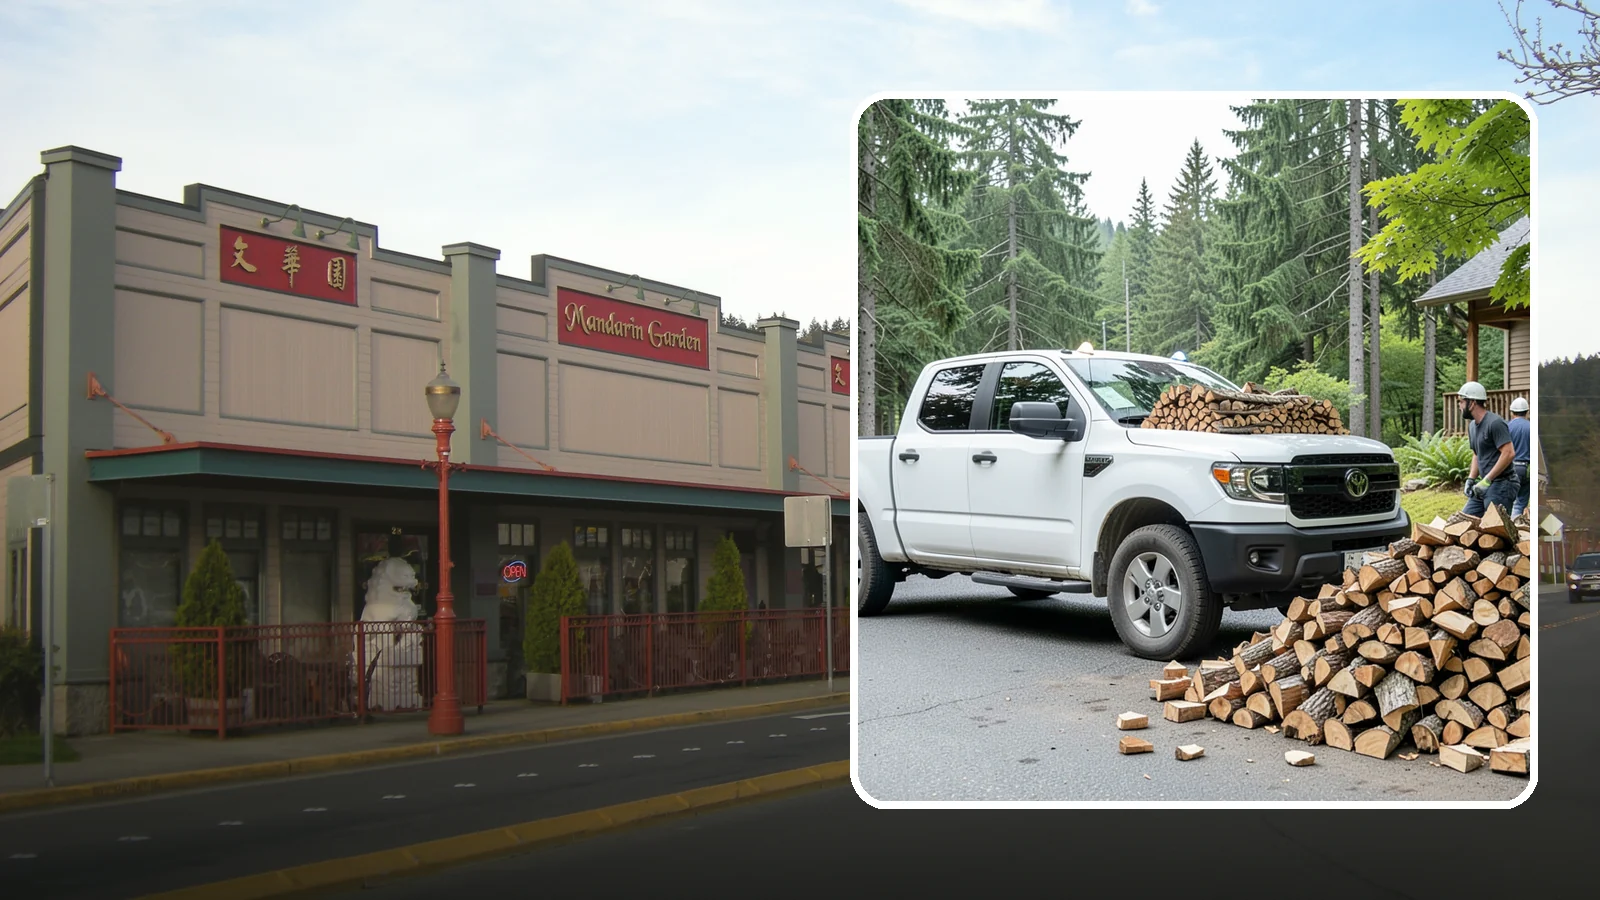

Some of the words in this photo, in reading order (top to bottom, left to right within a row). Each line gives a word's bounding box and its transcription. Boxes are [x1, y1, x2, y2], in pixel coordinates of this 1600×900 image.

[230, 236, 346, 290] 文華園
[564, 302, 644, 340] Mandarin
[648, 320, 701, 352] Garden
[503, 565, 527, 578] OPEN
